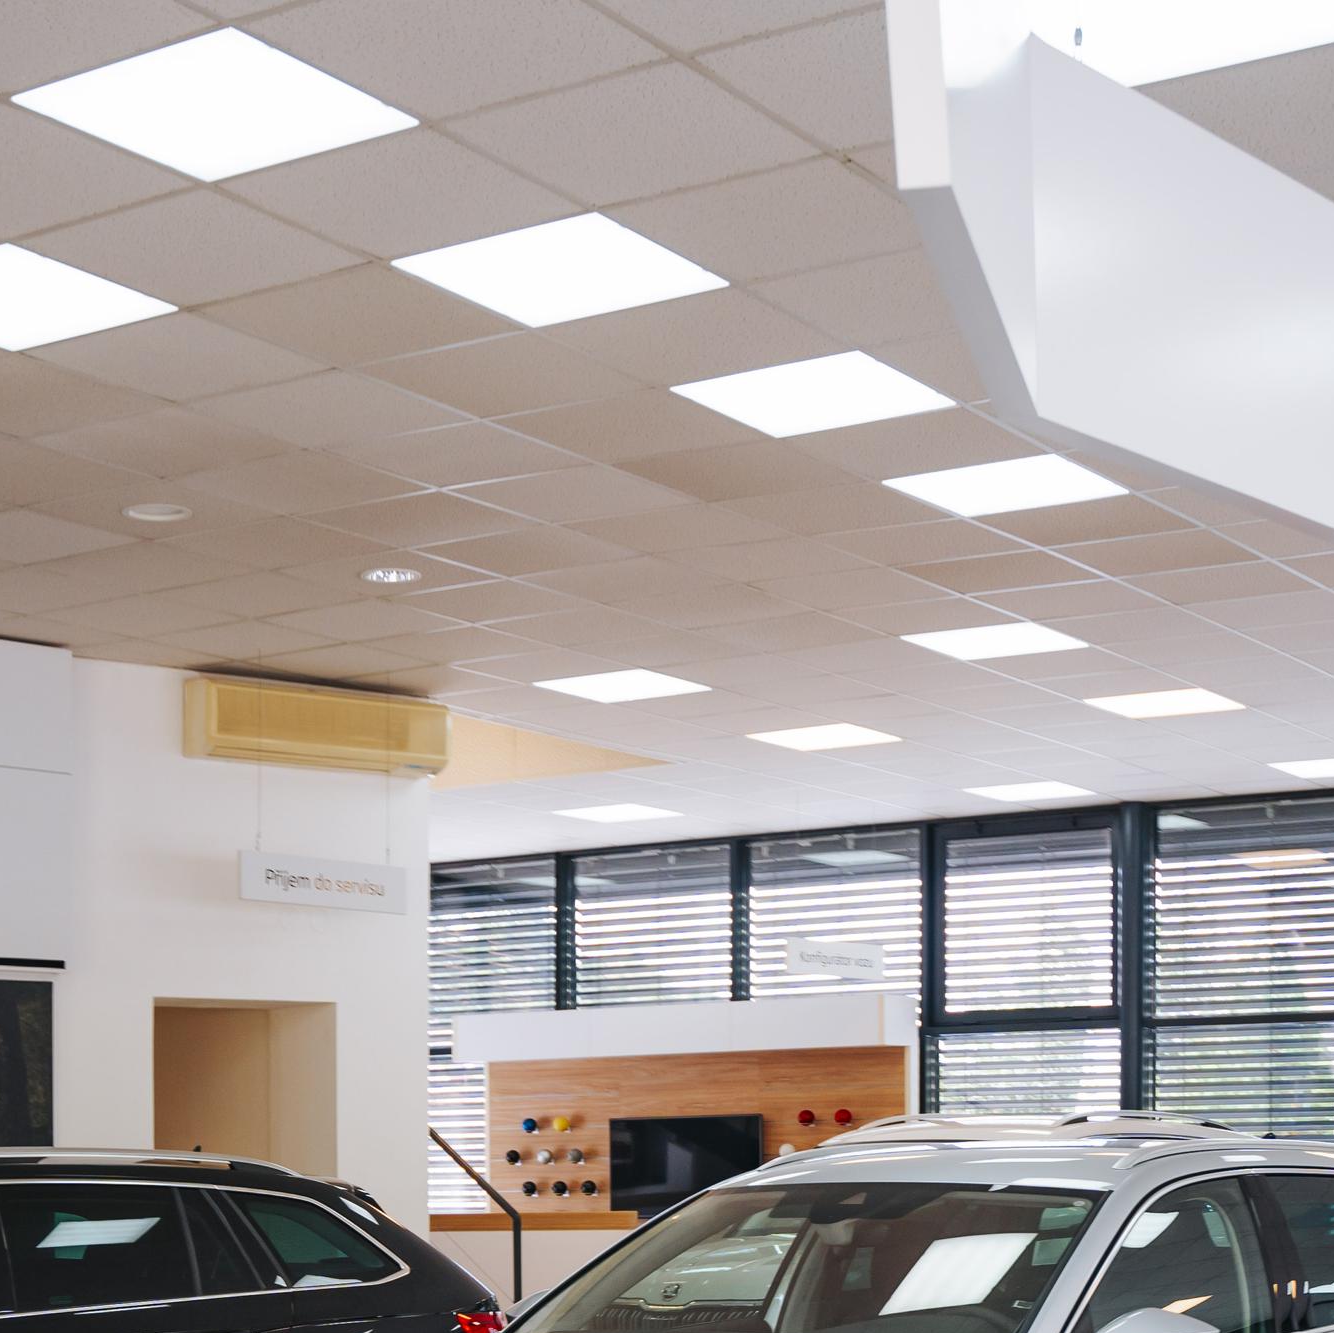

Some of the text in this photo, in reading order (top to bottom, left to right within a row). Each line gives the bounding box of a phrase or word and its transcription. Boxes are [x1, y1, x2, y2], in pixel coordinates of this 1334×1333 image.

[265, 867, 386, 897] Příjem do servisu
